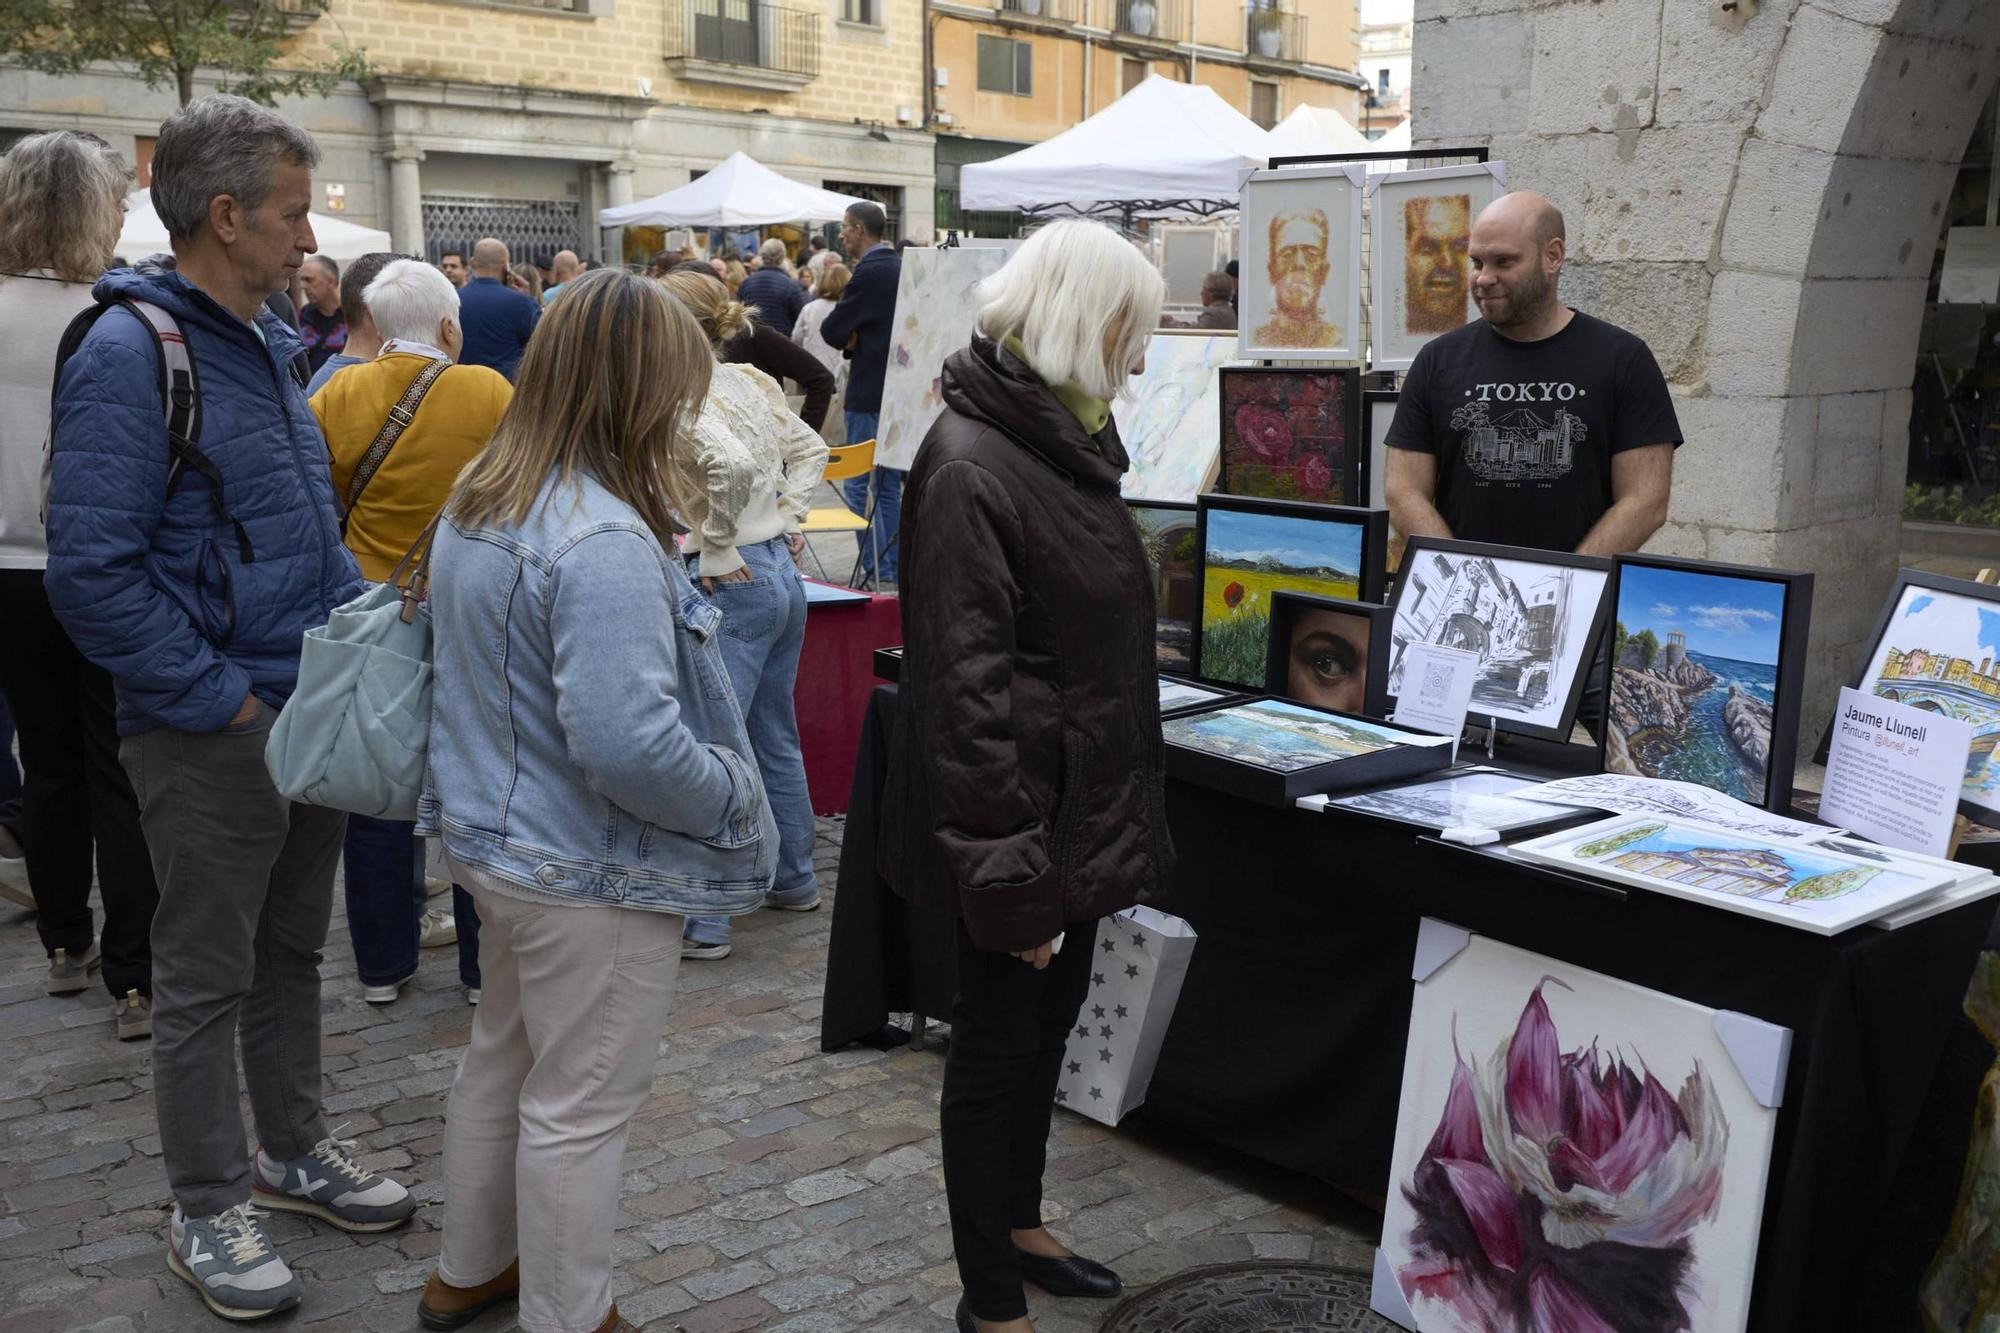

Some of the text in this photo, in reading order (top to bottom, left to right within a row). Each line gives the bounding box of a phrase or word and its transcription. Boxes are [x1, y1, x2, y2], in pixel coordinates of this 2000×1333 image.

[1475, 382, 1576, 402] TOKYO
[1841, 722, 1871, 741] Pintura
[1845, 704, 1927, 742] Jaume Llunell
